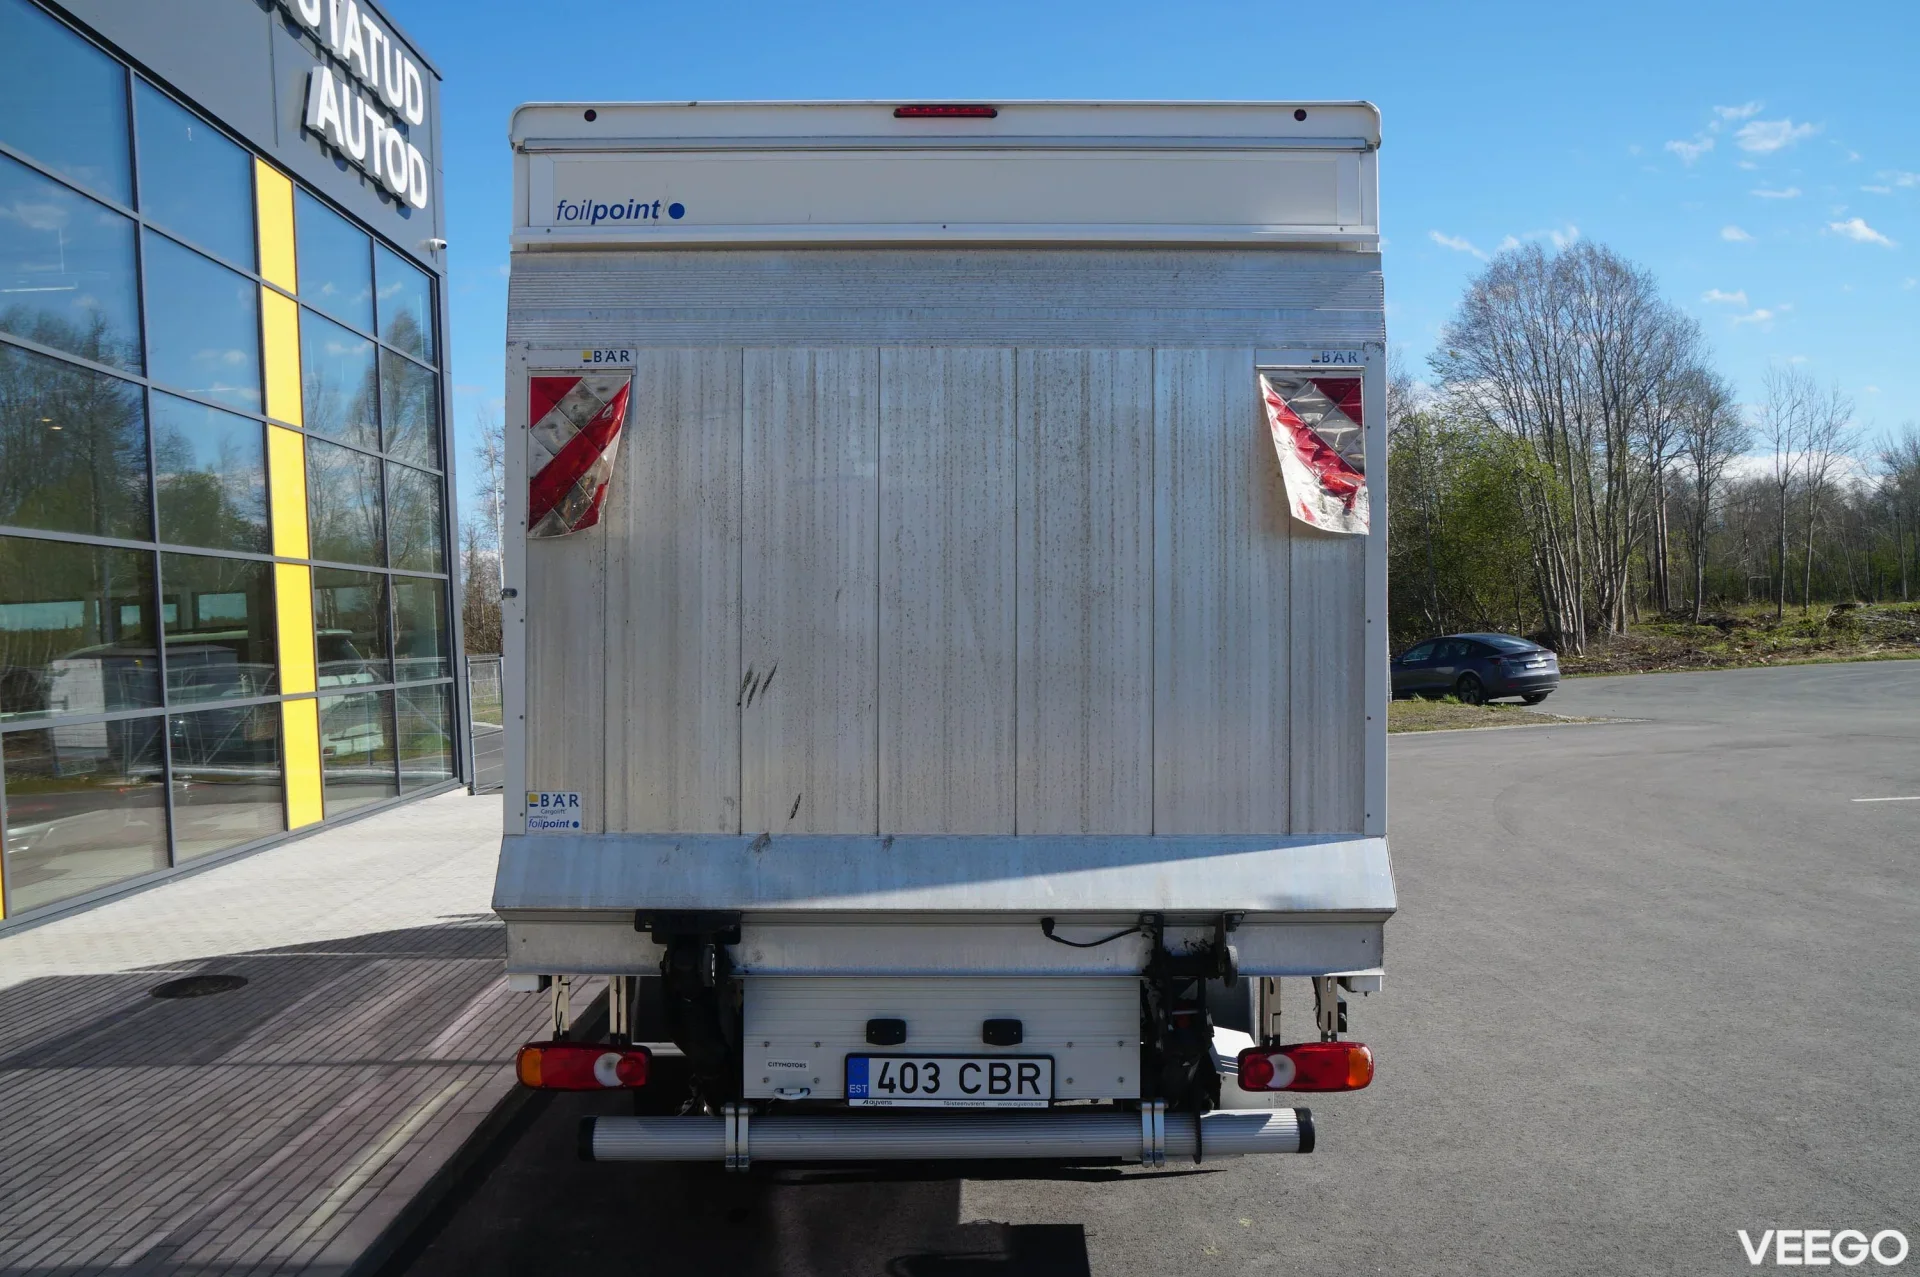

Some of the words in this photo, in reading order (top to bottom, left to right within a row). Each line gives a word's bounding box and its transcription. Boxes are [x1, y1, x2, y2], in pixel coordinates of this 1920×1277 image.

[308, 65, 428, 210] AUTOD
[556, 198, 662, 226] foilpoint
[593, 349, 630, 363] BÄR
[540, 793, 579, 808] BÄR
[528, 818, 570, 830] foilpoint
[877, 1061, 941, 1094] 403
[958, 1062, 1042, 1095] CBR
[849, 1084, 868, 1094] EST
